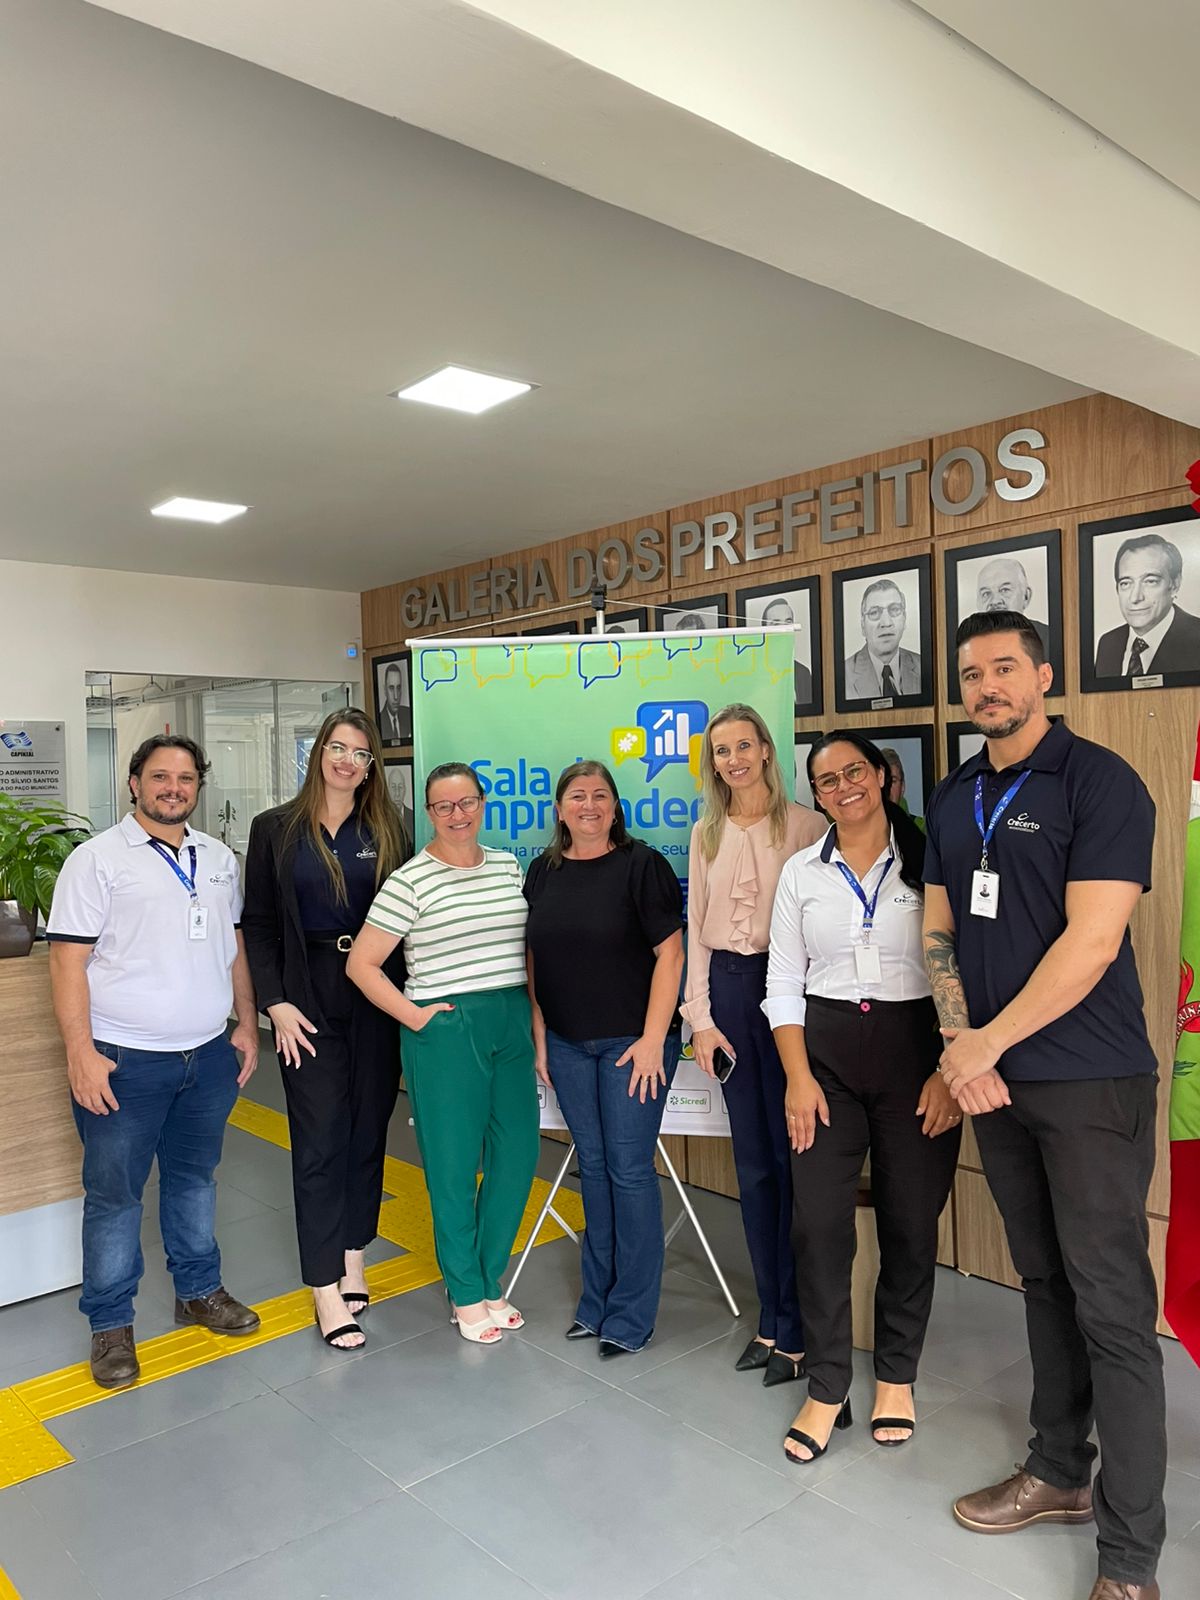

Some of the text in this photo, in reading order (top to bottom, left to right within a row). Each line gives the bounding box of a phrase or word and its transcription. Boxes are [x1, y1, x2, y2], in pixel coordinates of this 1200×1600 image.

[401, 427, 1047, 629] GALERIA DOS PREFEITOS
[470, 758, 549, 796] Sala
[1007, 818, 1040, 830] Crecerto
[680, 1097, 707, 1105] Sicredi
